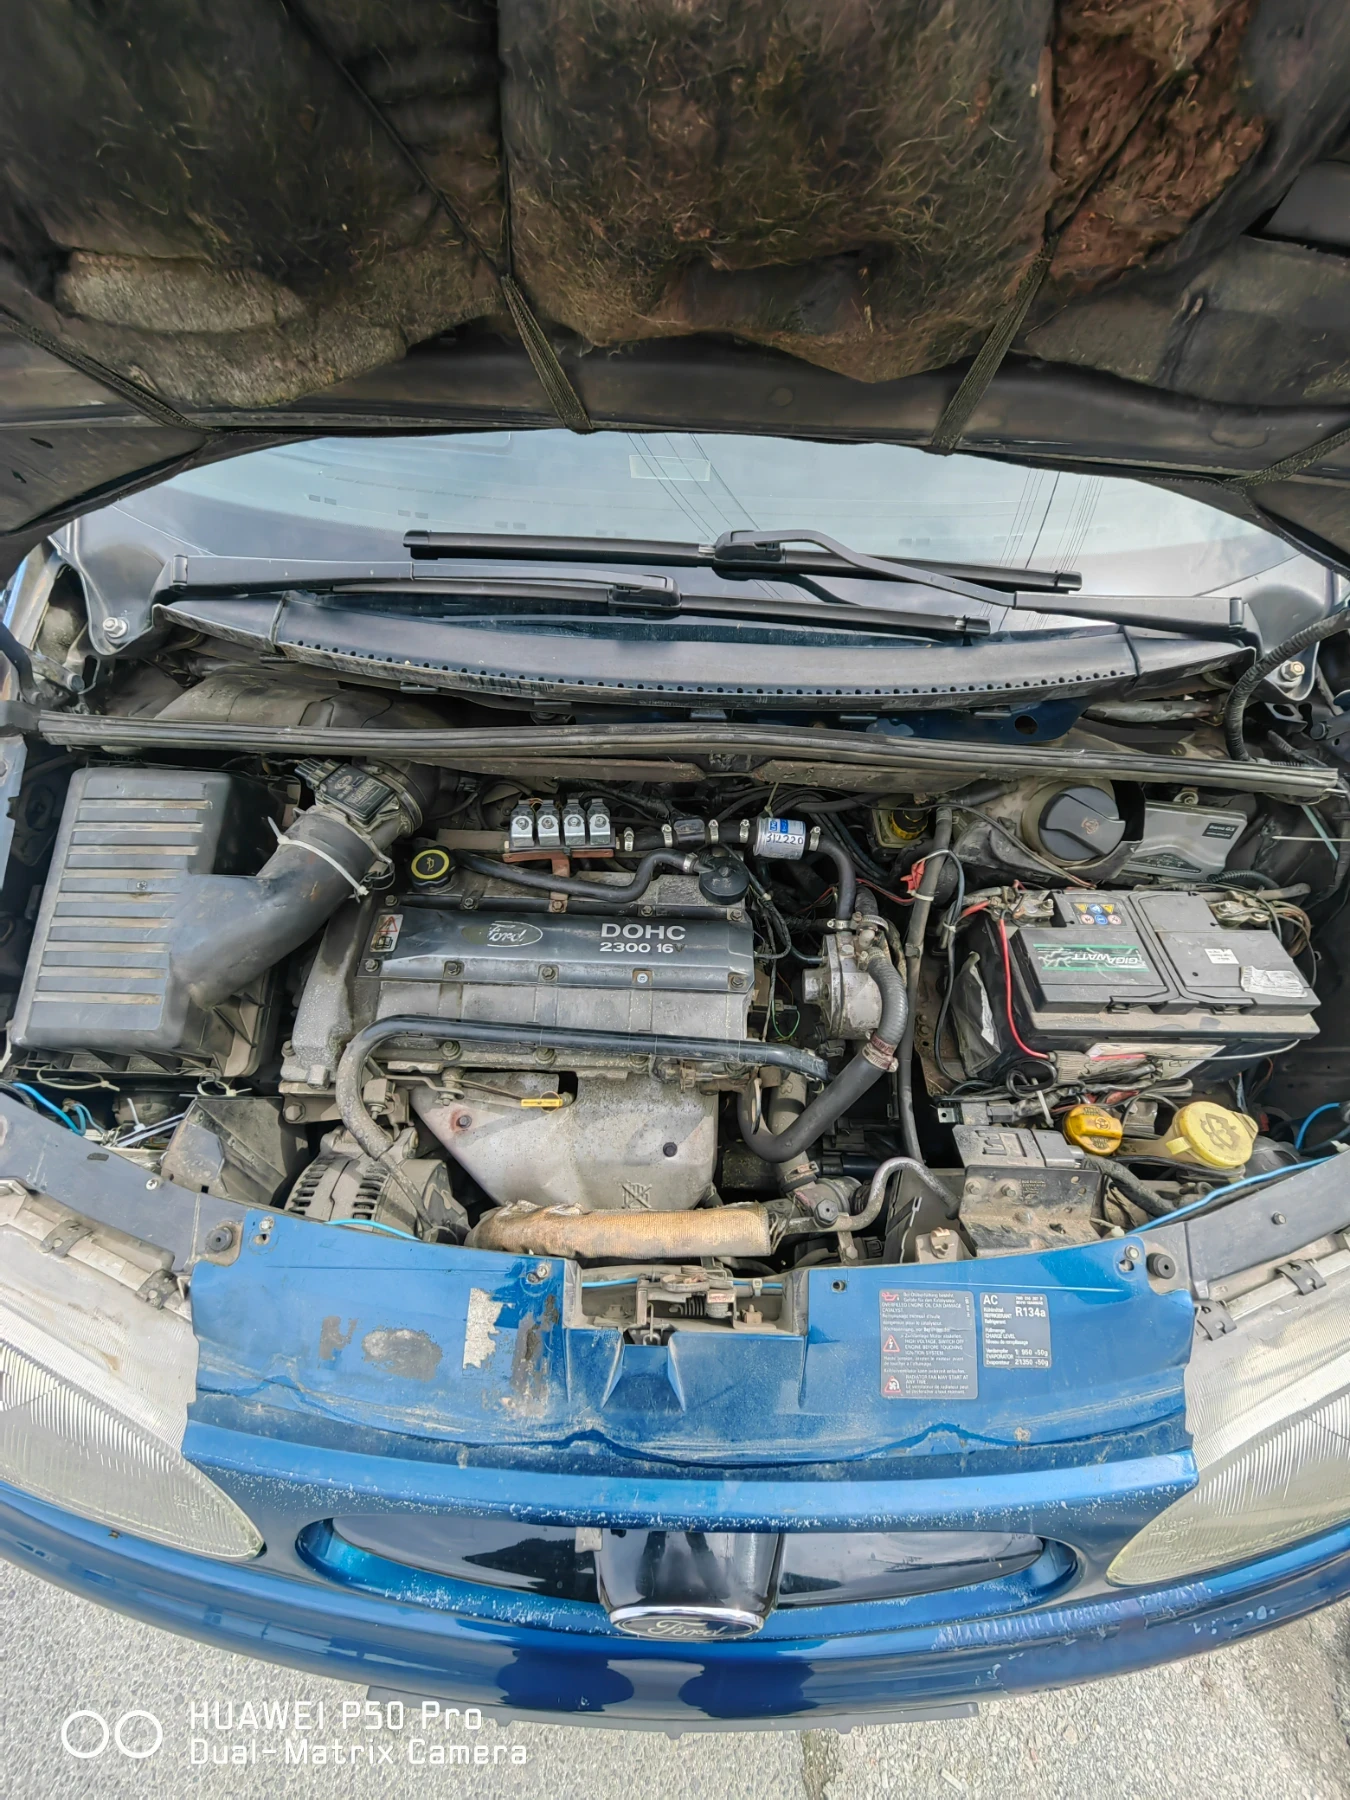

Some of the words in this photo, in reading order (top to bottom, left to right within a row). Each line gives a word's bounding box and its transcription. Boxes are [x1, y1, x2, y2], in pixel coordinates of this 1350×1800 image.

[766, 832, 804, 845] 312220
[487, 922, 527, 943] Ford
[601, 923, 686, 940] DOHC
[600, 942, 651, 953] 2300
[983, 1295, 998, 1304] AC
[1015, 1307, 1046, 1317] R134a
[648, 1620, 728, 1637] Ford
